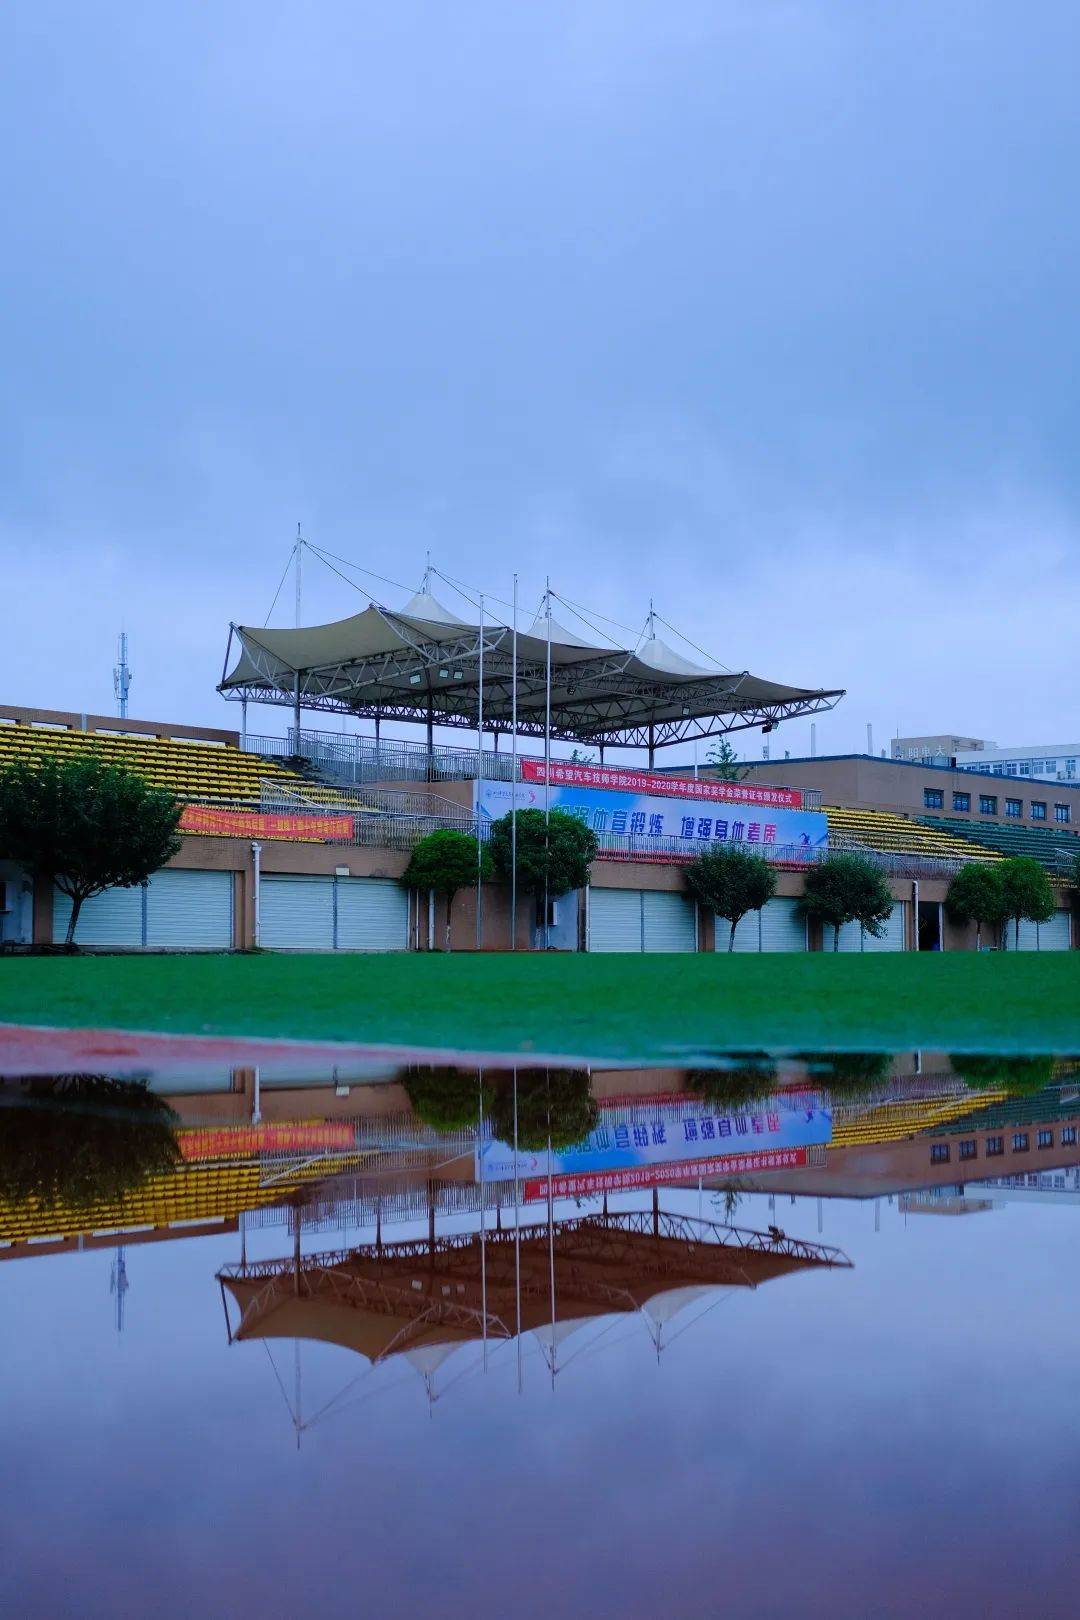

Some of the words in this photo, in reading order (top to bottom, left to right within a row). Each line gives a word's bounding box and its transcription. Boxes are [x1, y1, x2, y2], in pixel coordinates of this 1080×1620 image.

[681, 816, 777, 843] 增强身体素质
